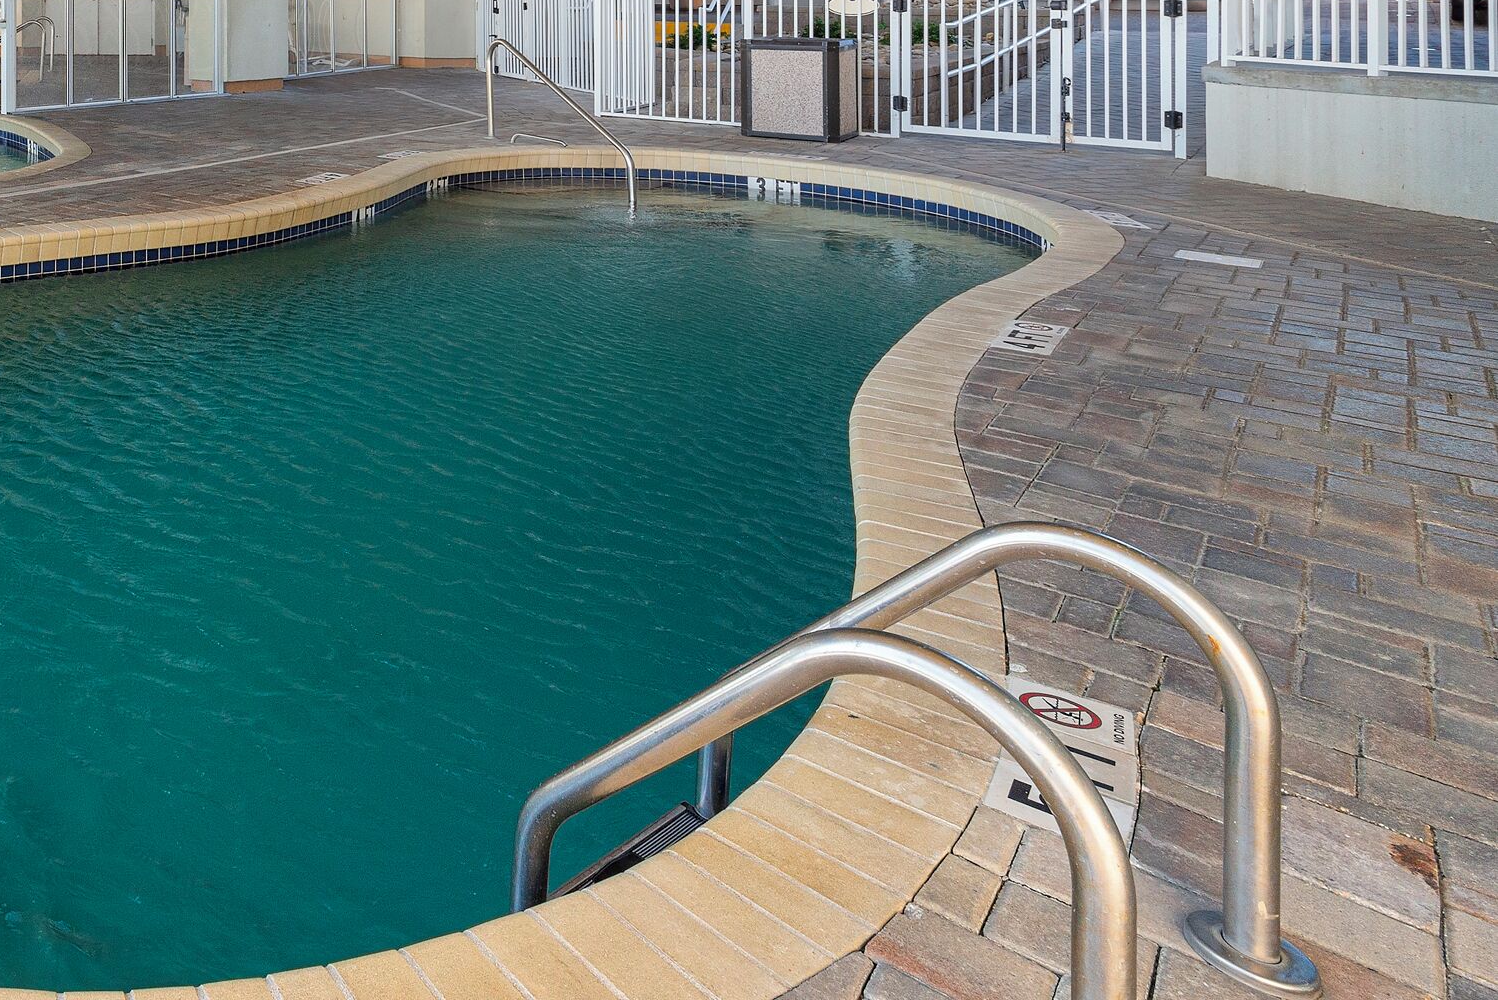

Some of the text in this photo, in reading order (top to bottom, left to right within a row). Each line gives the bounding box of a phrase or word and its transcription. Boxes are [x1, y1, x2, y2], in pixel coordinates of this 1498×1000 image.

[756, 177, 799, 194] 3 FT
[1114, 714, 1125, 745] NO DIVING
